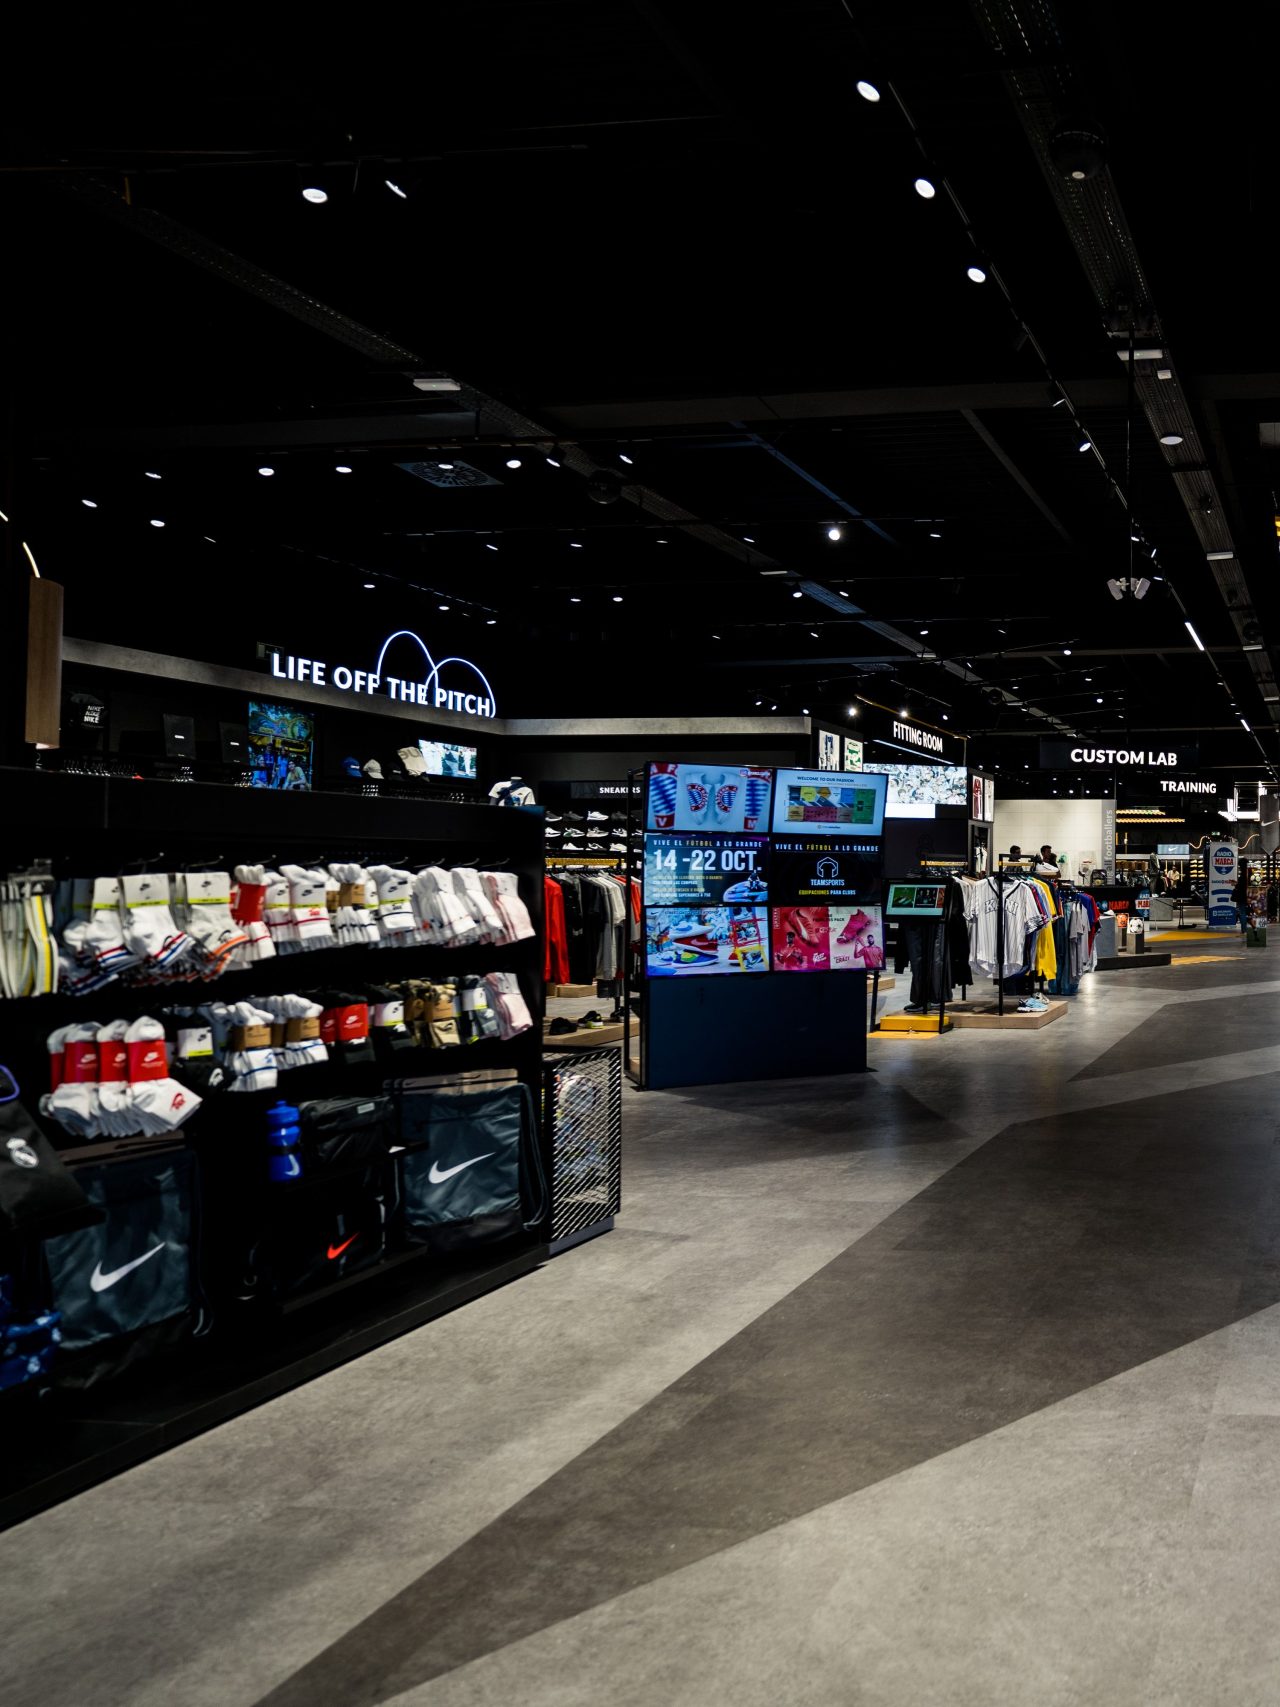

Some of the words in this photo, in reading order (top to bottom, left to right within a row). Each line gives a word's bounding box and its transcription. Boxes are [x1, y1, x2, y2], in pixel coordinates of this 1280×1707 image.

[271, 652, 326, 686] LIFE
[333, 666, 379, 695] OFF
[386, 676, 429, 706] THE
[435, 687, 491, 717] PITCH
[893, 720, 922, 746] FITTING
[923, 731, 943, 753] ROOM
[1070, 748, 1145, 765] CUSTOM
[1148, 751, 1178, 766] LAB
[1160, 780, 1217, 794] TRAINING
[653, 849, 677, 871] 14
[721, 849, 762, 871] OCT.
